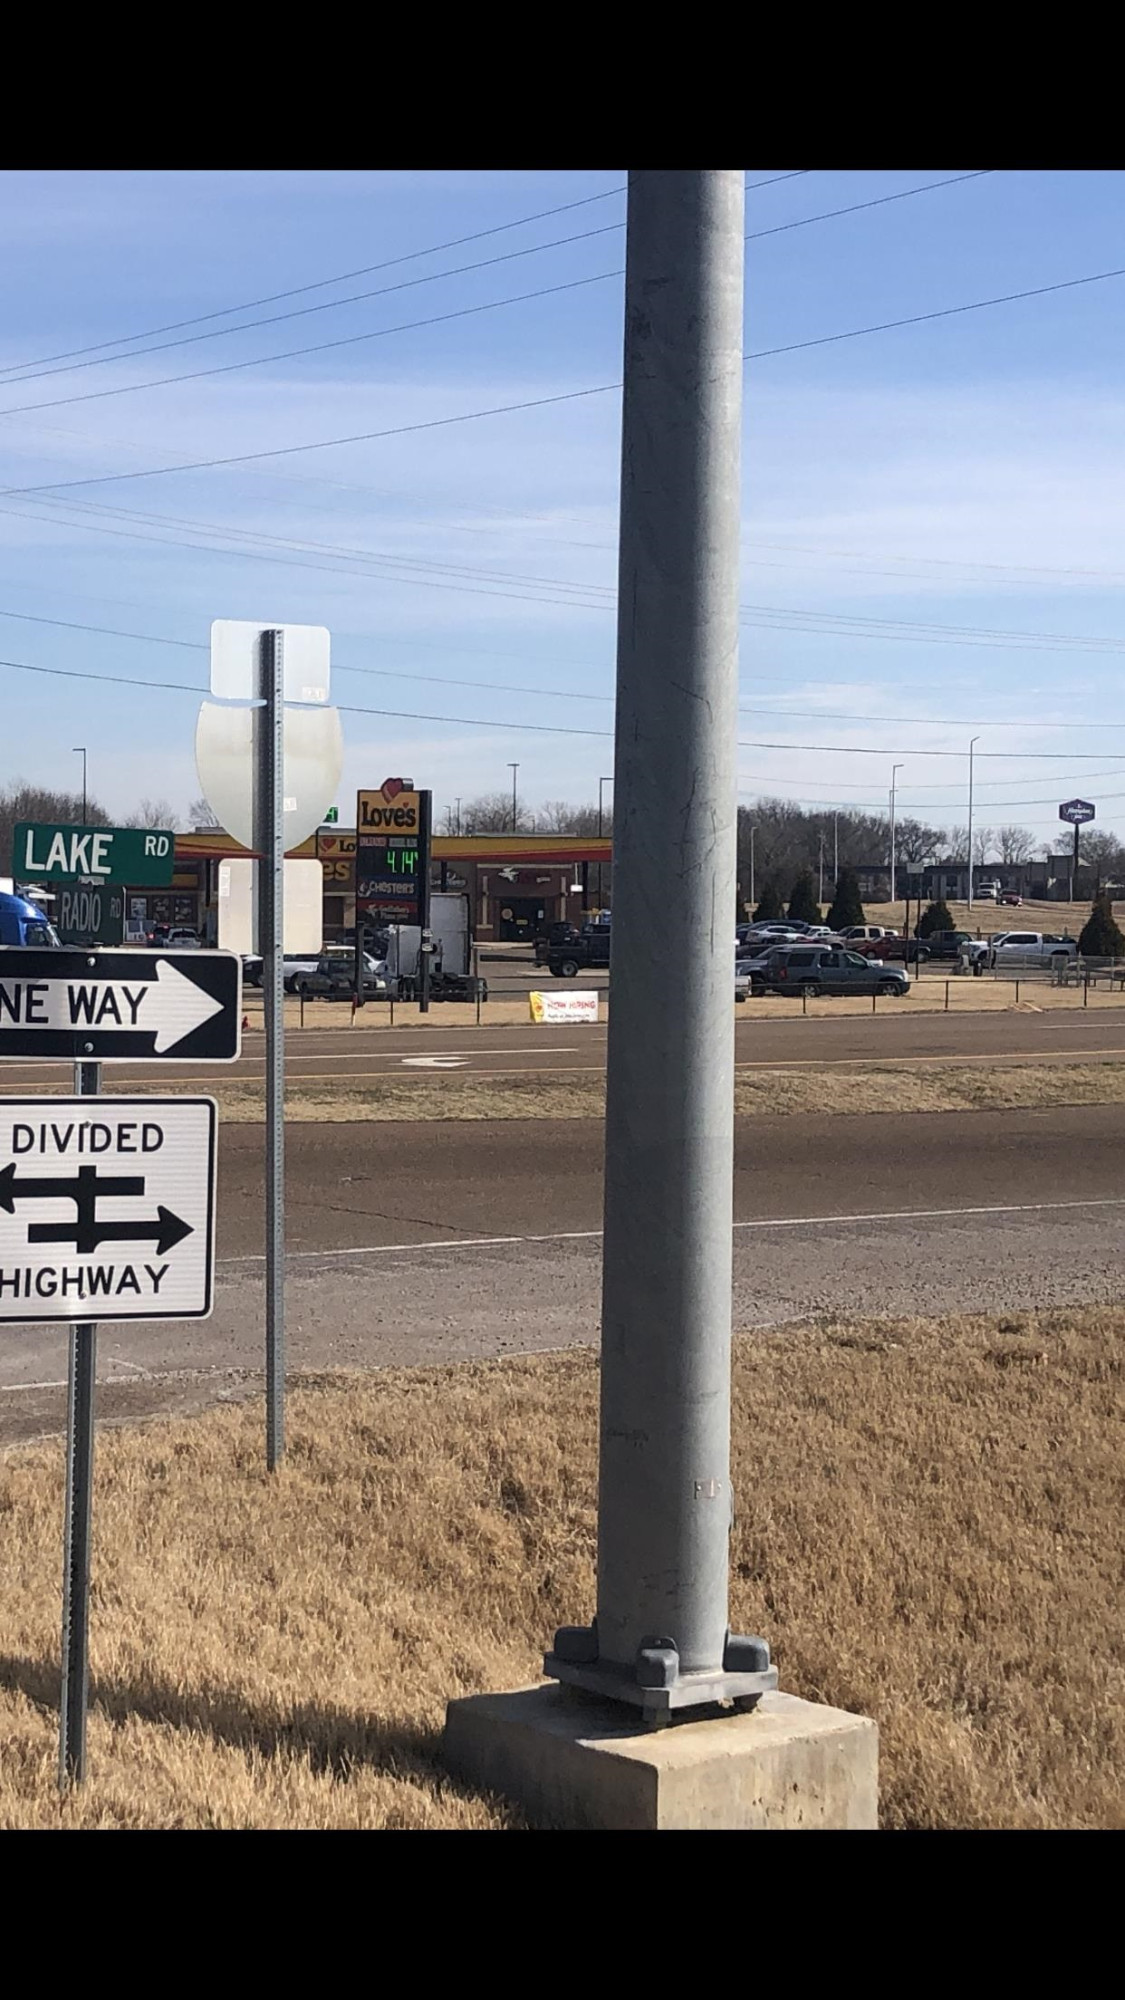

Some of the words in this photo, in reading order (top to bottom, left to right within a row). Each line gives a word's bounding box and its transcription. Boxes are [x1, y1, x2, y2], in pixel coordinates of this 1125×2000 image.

[361, 801, 416, 827] Love's
[25, 829, 113, 875] LAKE
[144, 835, 169, 857] RD
[61, 891, 101, 933] RADIO
[109, 897, 121, 919] RD
[0, 983, 49, 1024] NE
[67, 985, 148, 1025] WAY
[12, 1123, 164, 1154] DIVIDED
[0, 1264, 170, 1298] HIGHWAY
